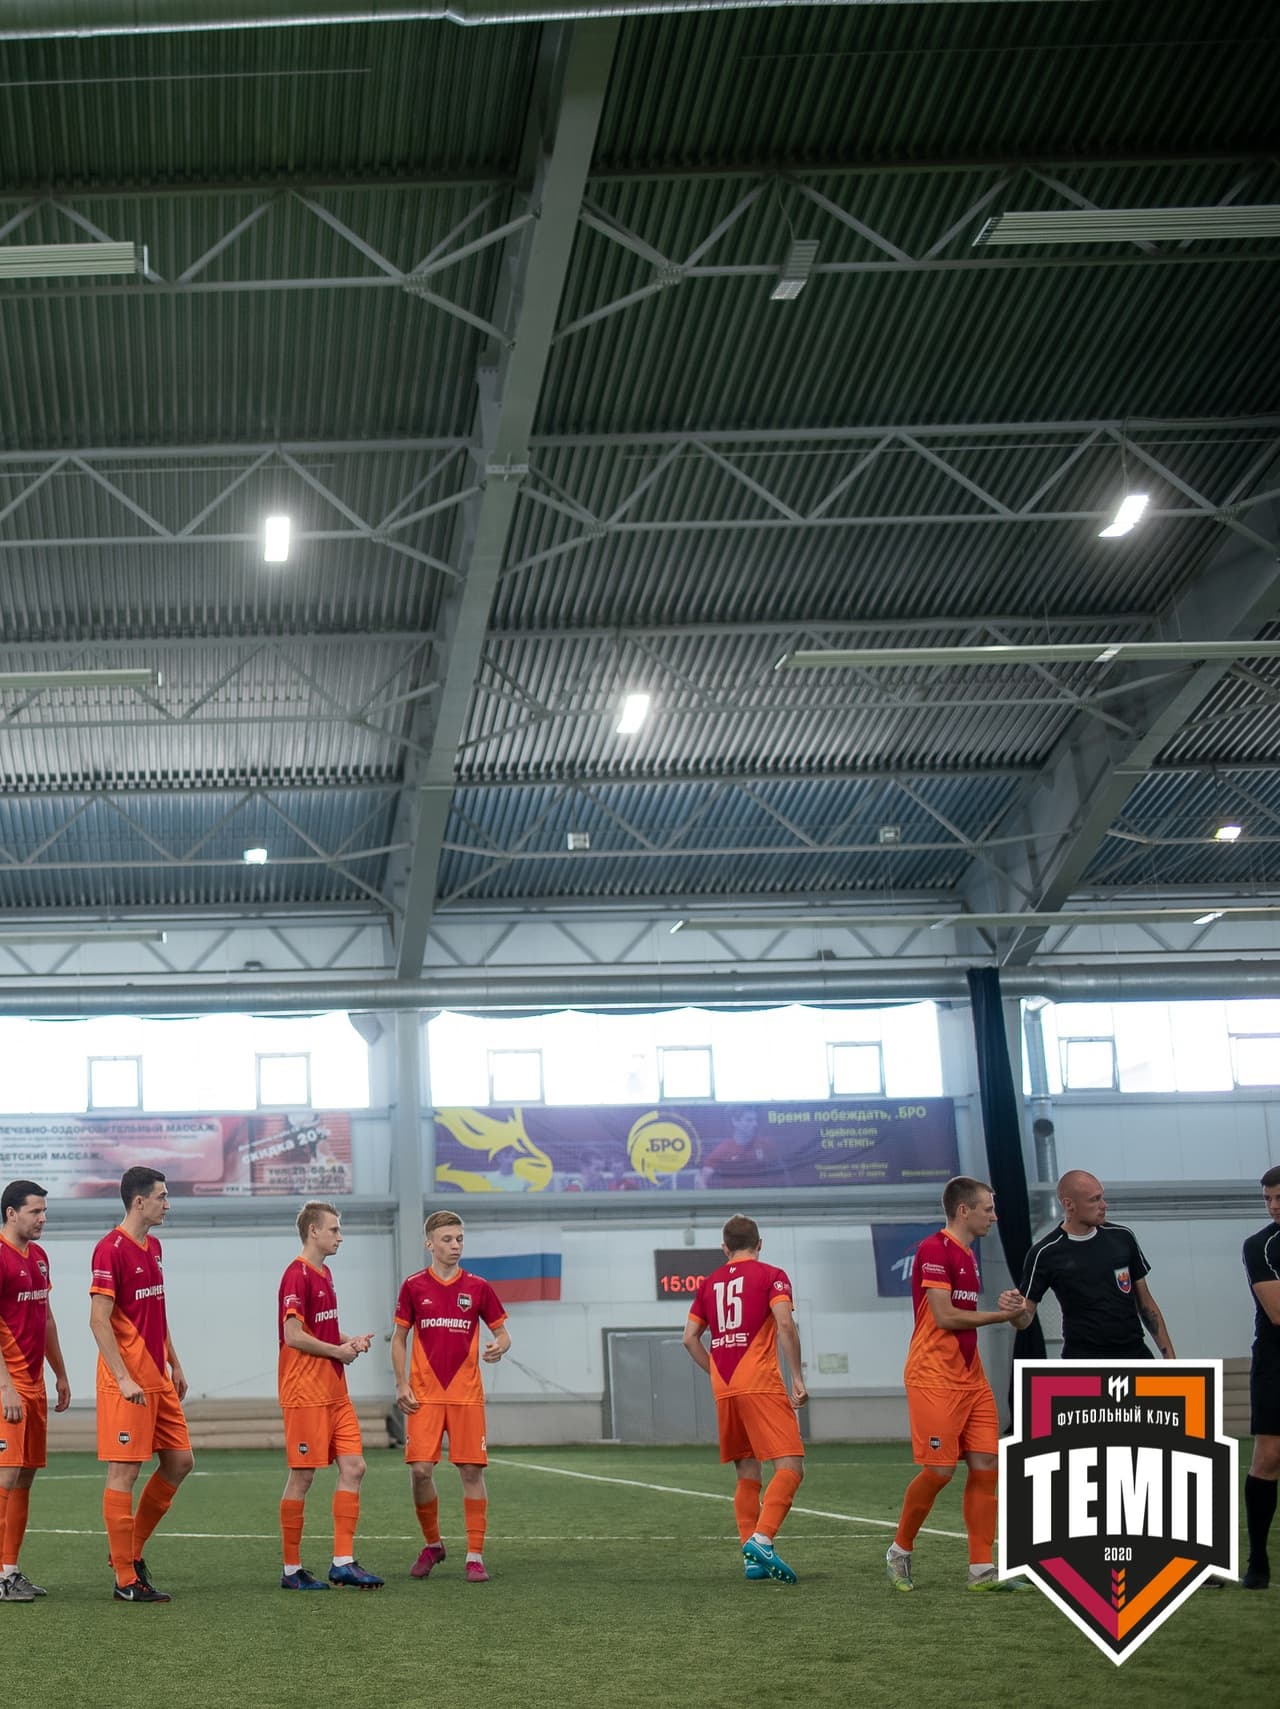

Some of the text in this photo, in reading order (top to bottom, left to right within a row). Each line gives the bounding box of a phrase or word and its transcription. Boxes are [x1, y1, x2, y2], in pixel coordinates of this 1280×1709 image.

[768, 1106, 927, 1124] Время побеждать, .БРО
[645, 1138, 686, 1153] .БРО
[713, 1276, 744, 1332] 15
[420, 1317, 472, 1330] ПРОДИНВЕСТ
